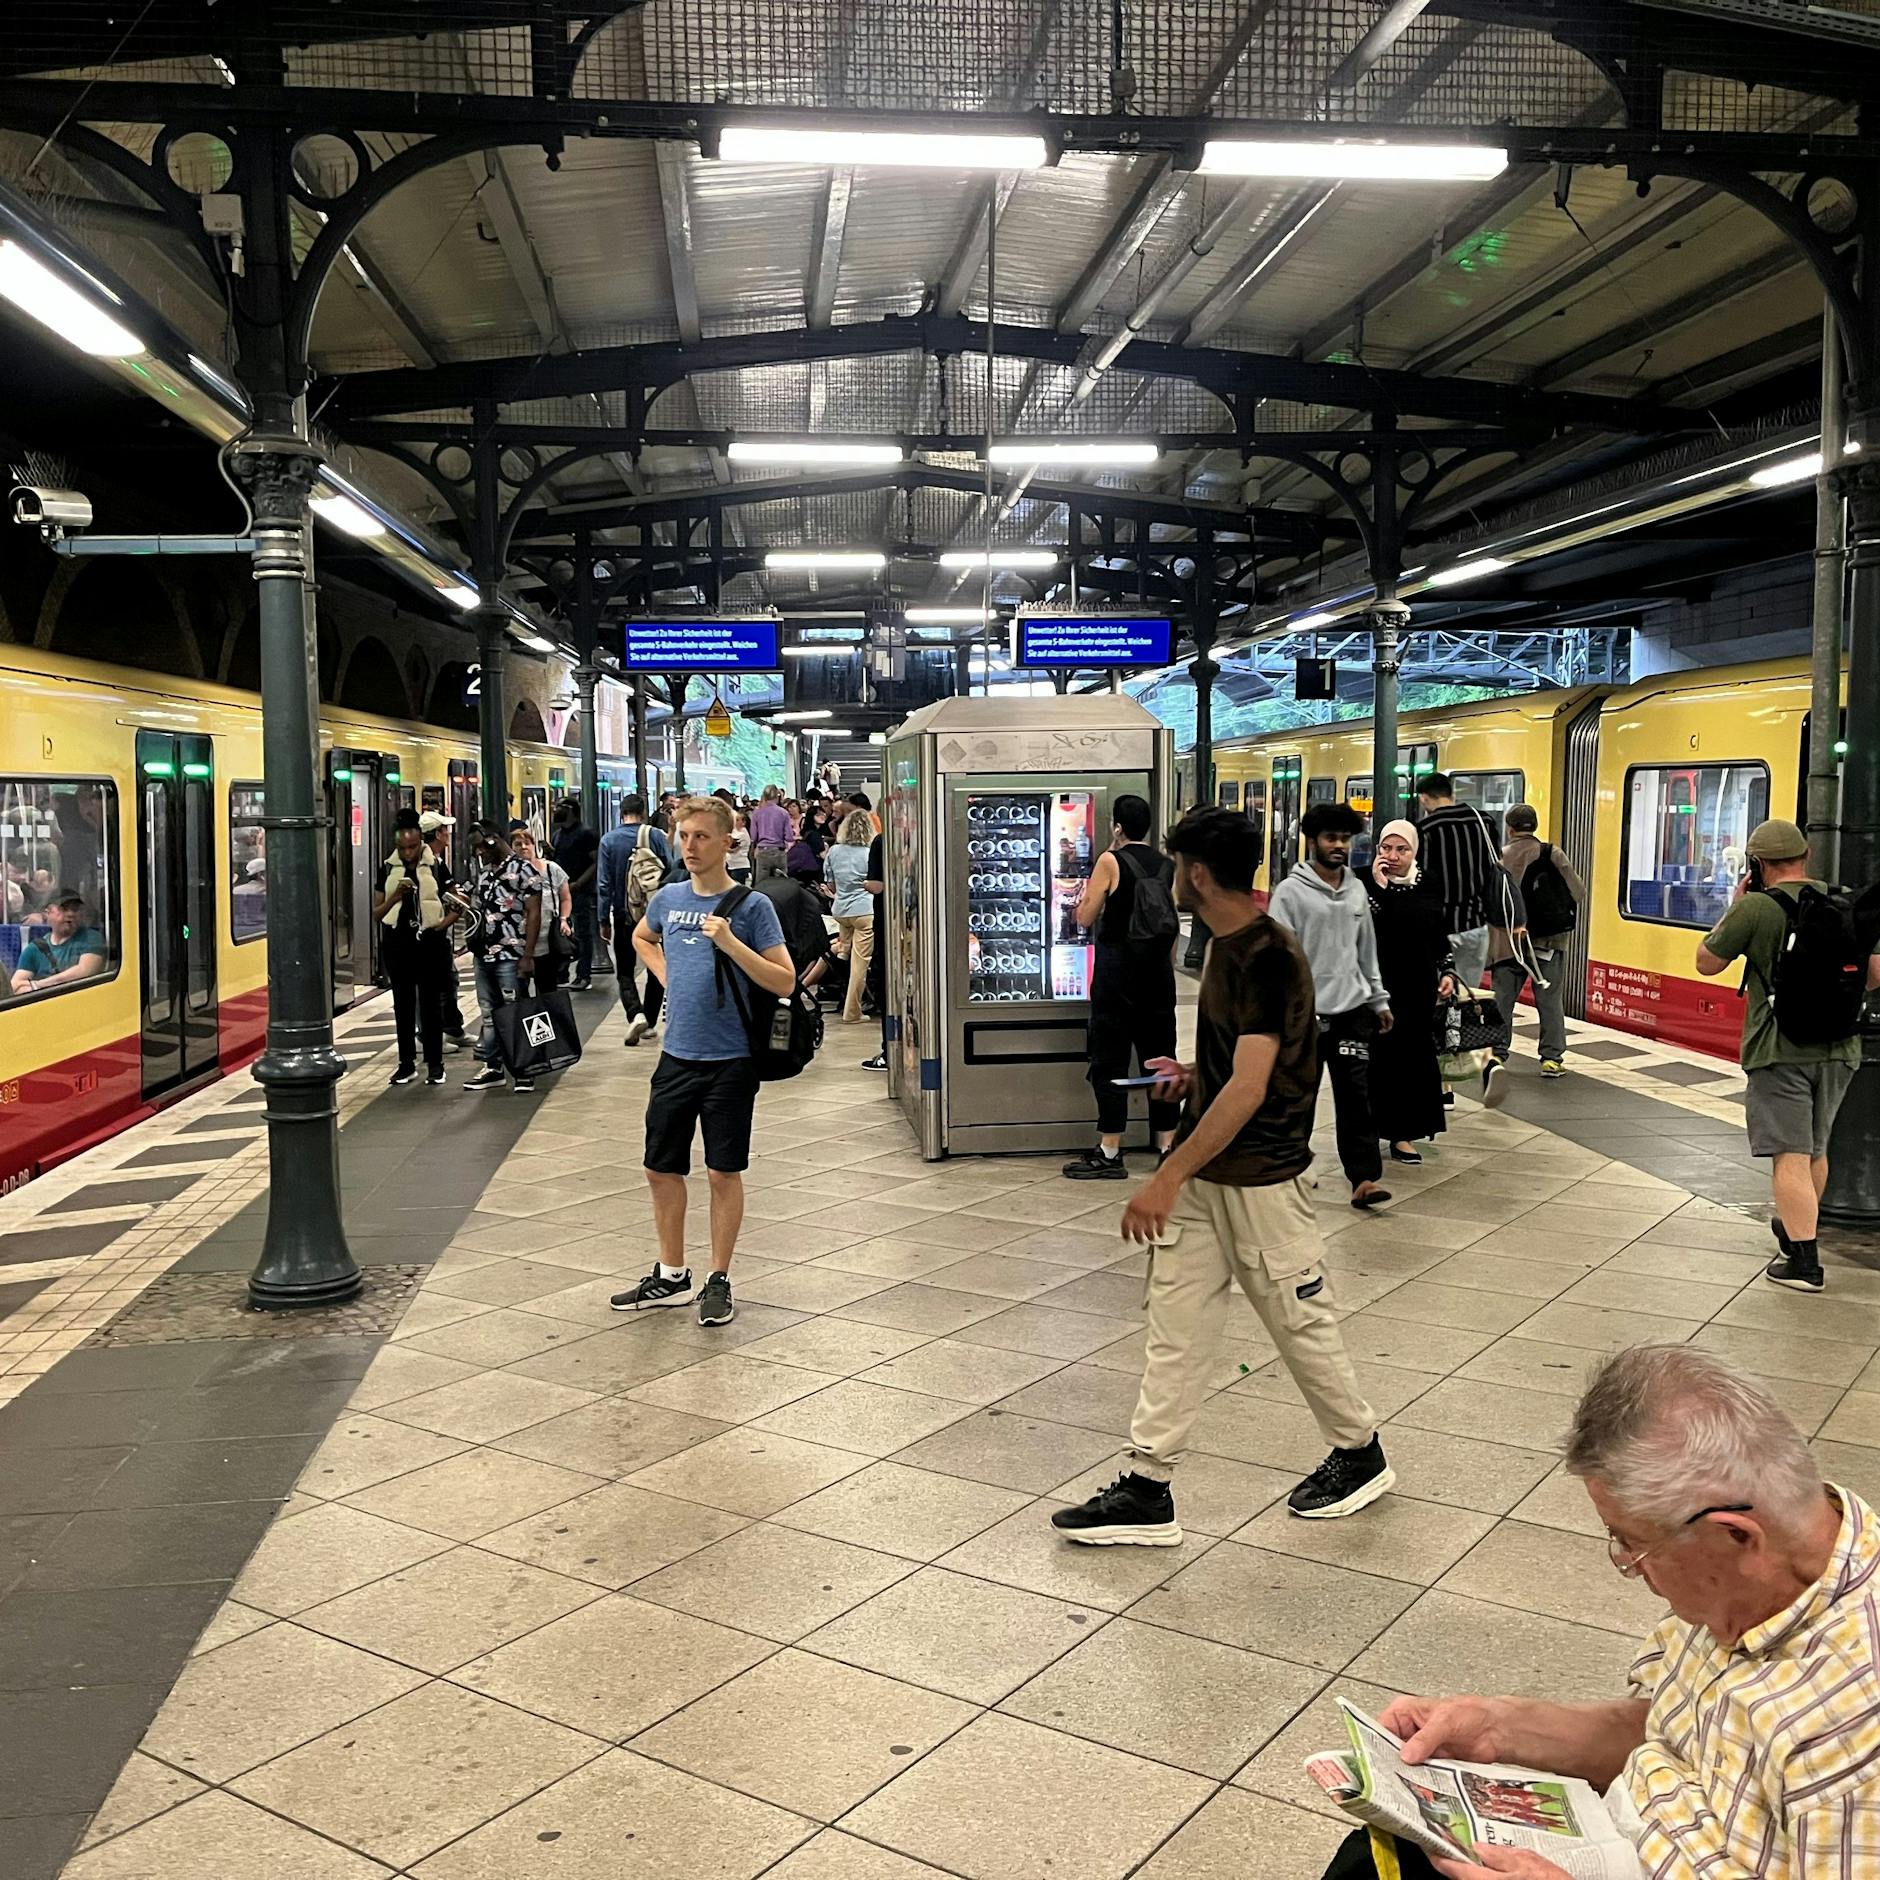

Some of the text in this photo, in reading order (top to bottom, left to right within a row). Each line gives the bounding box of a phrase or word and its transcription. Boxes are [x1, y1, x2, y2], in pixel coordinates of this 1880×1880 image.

[682, 630, 712, 638] Sicherheit
[713, 630, 721, 638] ist
[722, 630, 732, 638] der
[1080, 627, 1109, 635] Sicherheit
[1118, 627, 1128, 635] der
[629, 641, 654, 651] gesamte
[1027, 638, 1052, 648] gesamte
[641, 653, 650, 661] auf
[1038, 649, 1047, 657] auf
[467, 663, 481, 695] 2
[1319, 660, 1331, 690] 1
